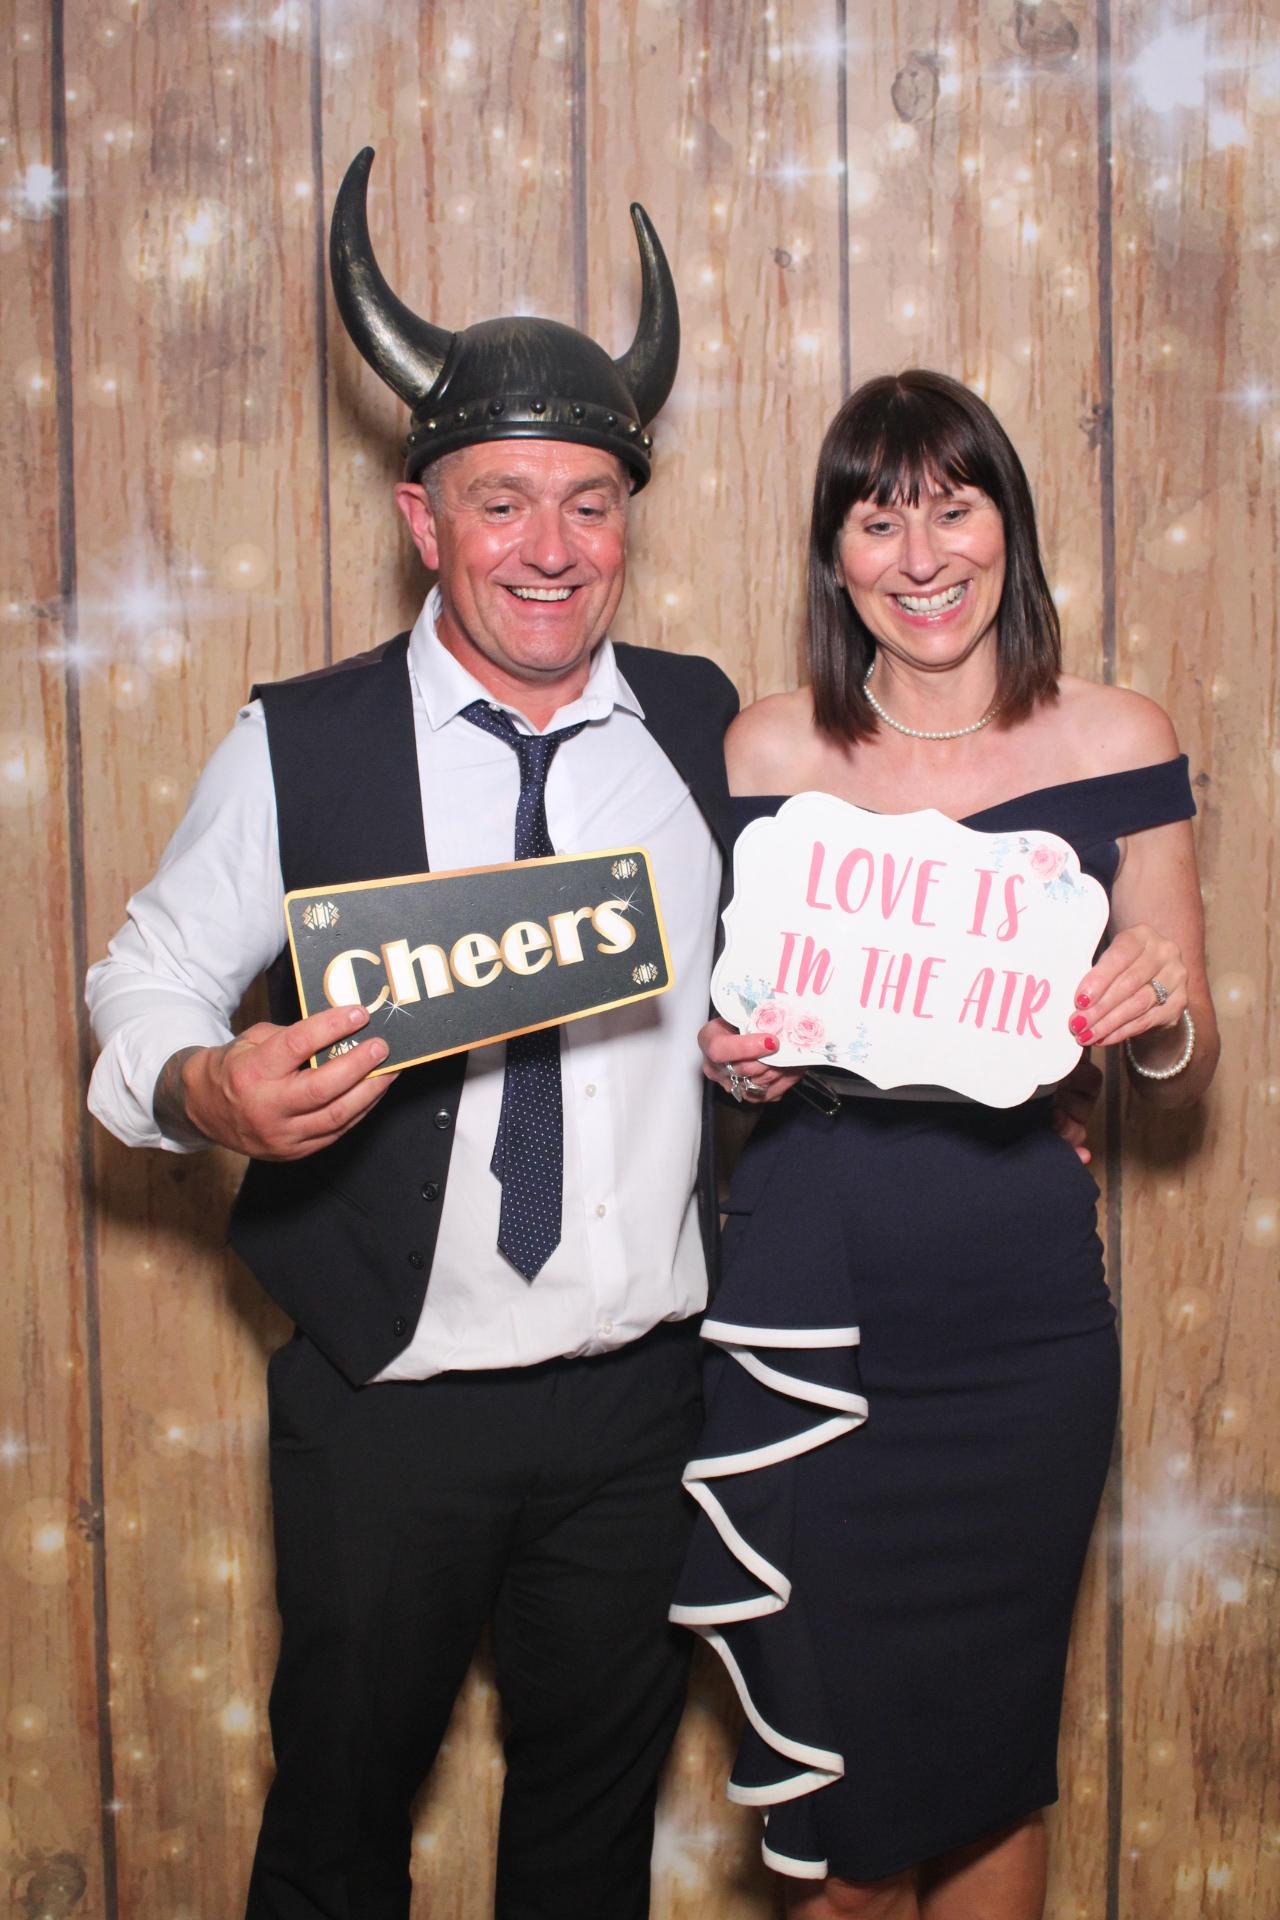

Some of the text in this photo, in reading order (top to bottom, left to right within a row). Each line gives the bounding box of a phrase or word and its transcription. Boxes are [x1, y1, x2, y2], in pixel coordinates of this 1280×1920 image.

[806, 841, 1029, 942] LOVE IS
[323, 900, 637, 1014] Cheers
[771, 931, 1052, 1040] IN THE AIR
